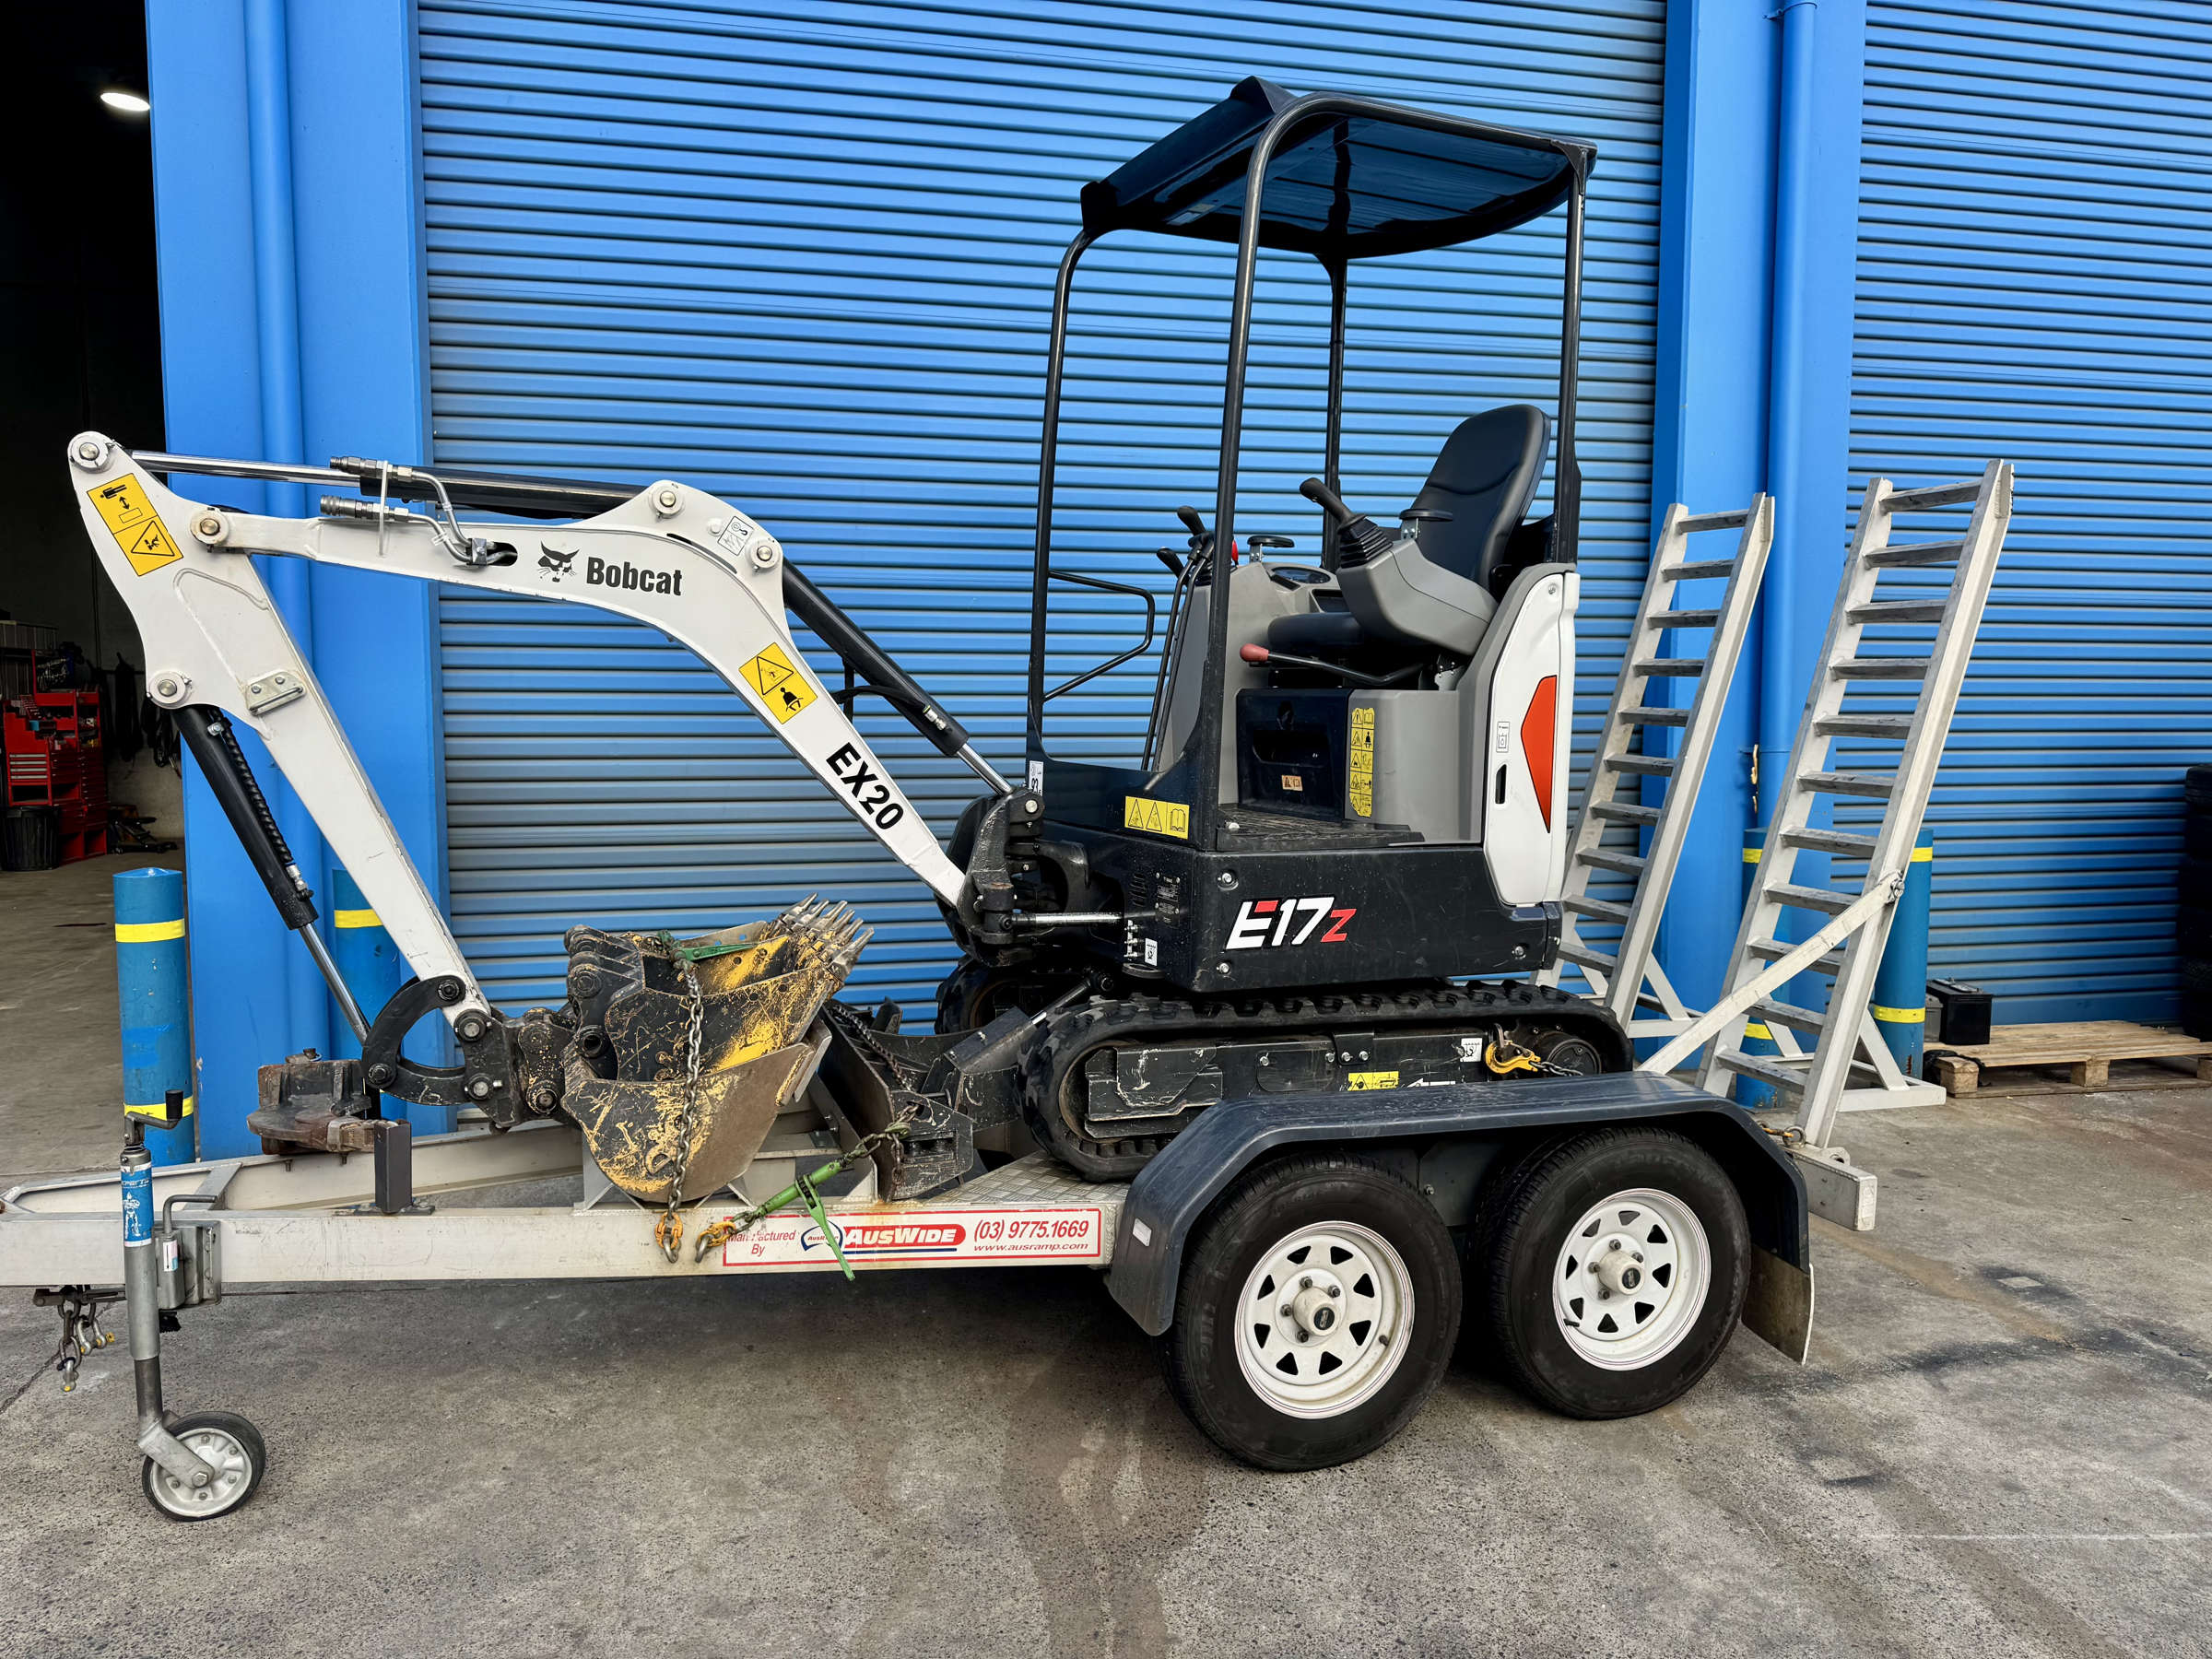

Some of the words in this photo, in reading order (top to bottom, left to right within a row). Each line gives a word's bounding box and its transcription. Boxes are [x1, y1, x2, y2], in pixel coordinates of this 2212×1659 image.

[586, 556, 682, 595] Bobcat
[826, 742, 904, 830] EX20
[974, 1219, 1005, 1242] (03)
[1008, 1220, 1088, 1239] 9775.1669
[751, 1243, 766, 1257] By
[973, 1243, 1088, 1252] www.ausramp.com
